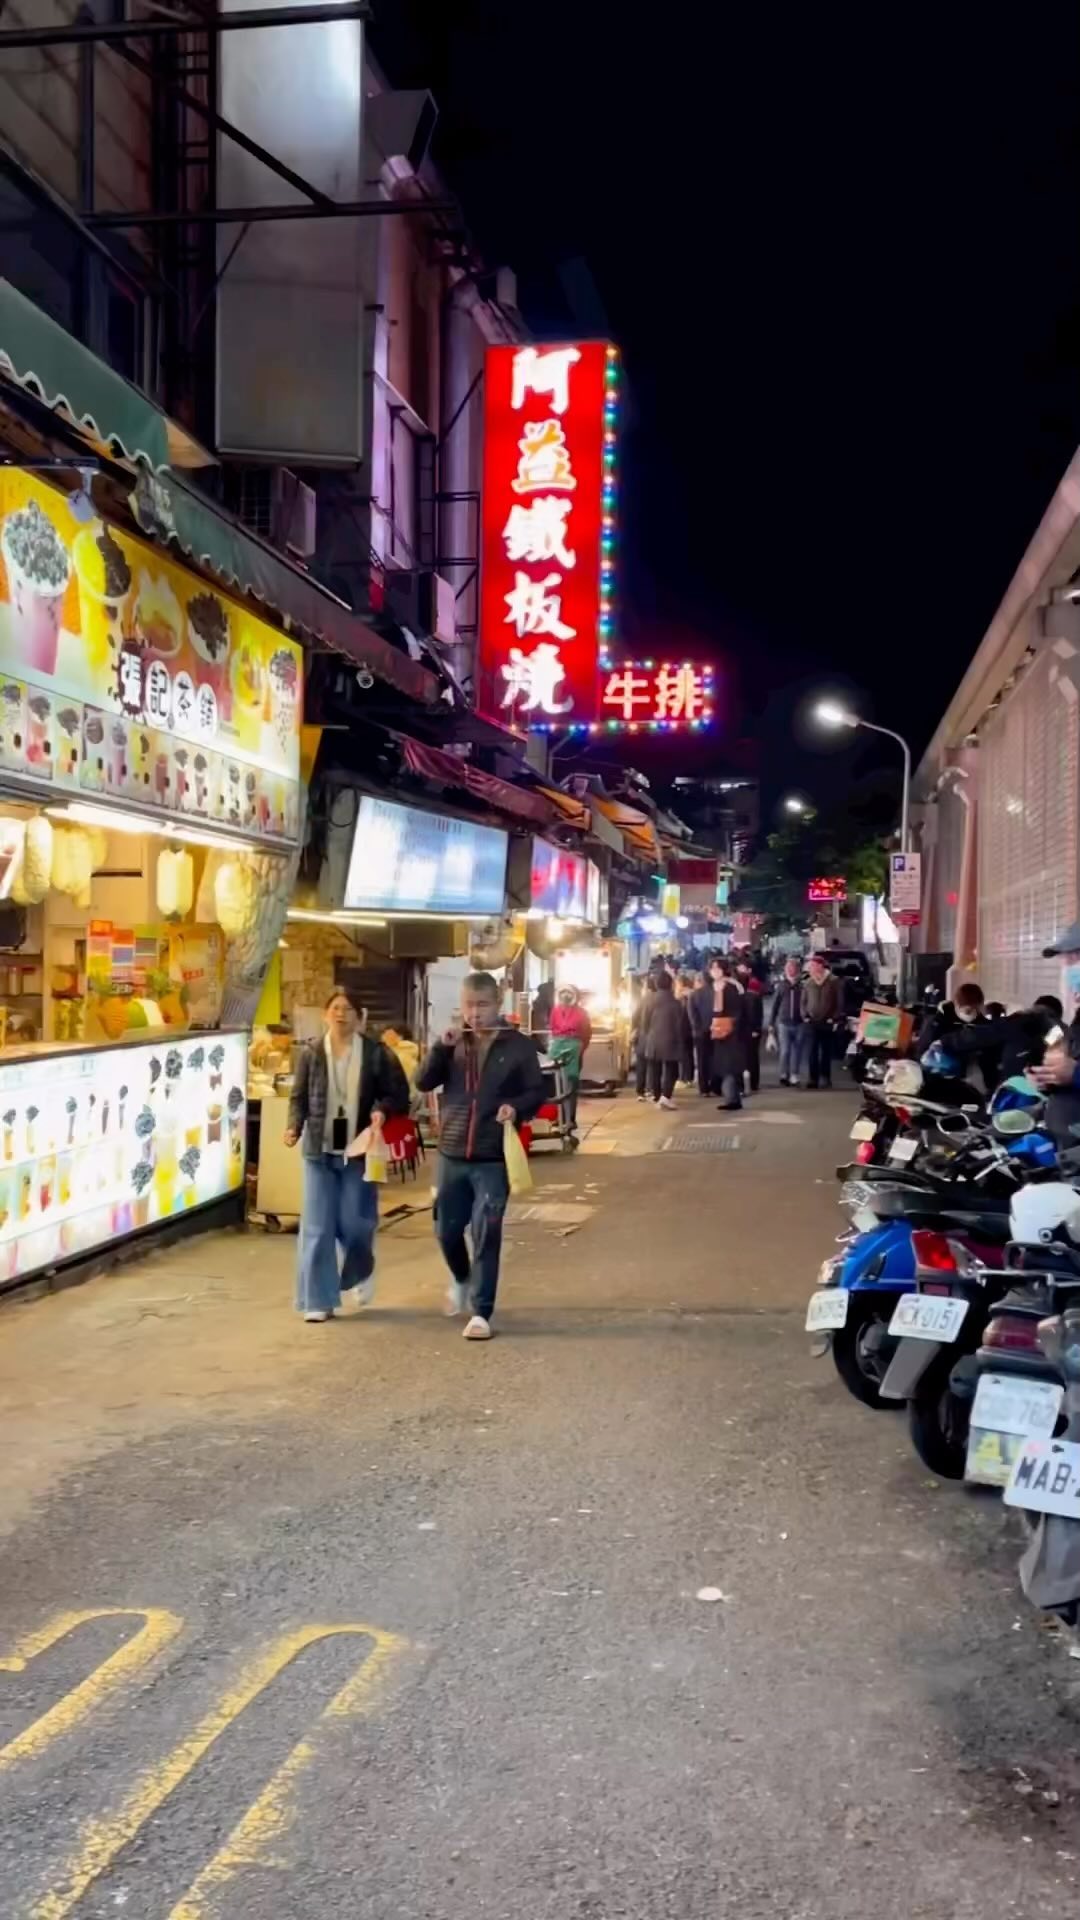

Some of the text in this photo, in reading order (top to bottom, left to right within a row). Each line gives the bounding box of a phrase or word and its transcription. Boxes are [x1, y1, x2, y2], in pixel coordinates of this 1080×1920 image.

[603, 668, 702, 718] 牛排
[894, 857, 904, 870] P
[1014, 1456, 1080, 1498] MAB-
